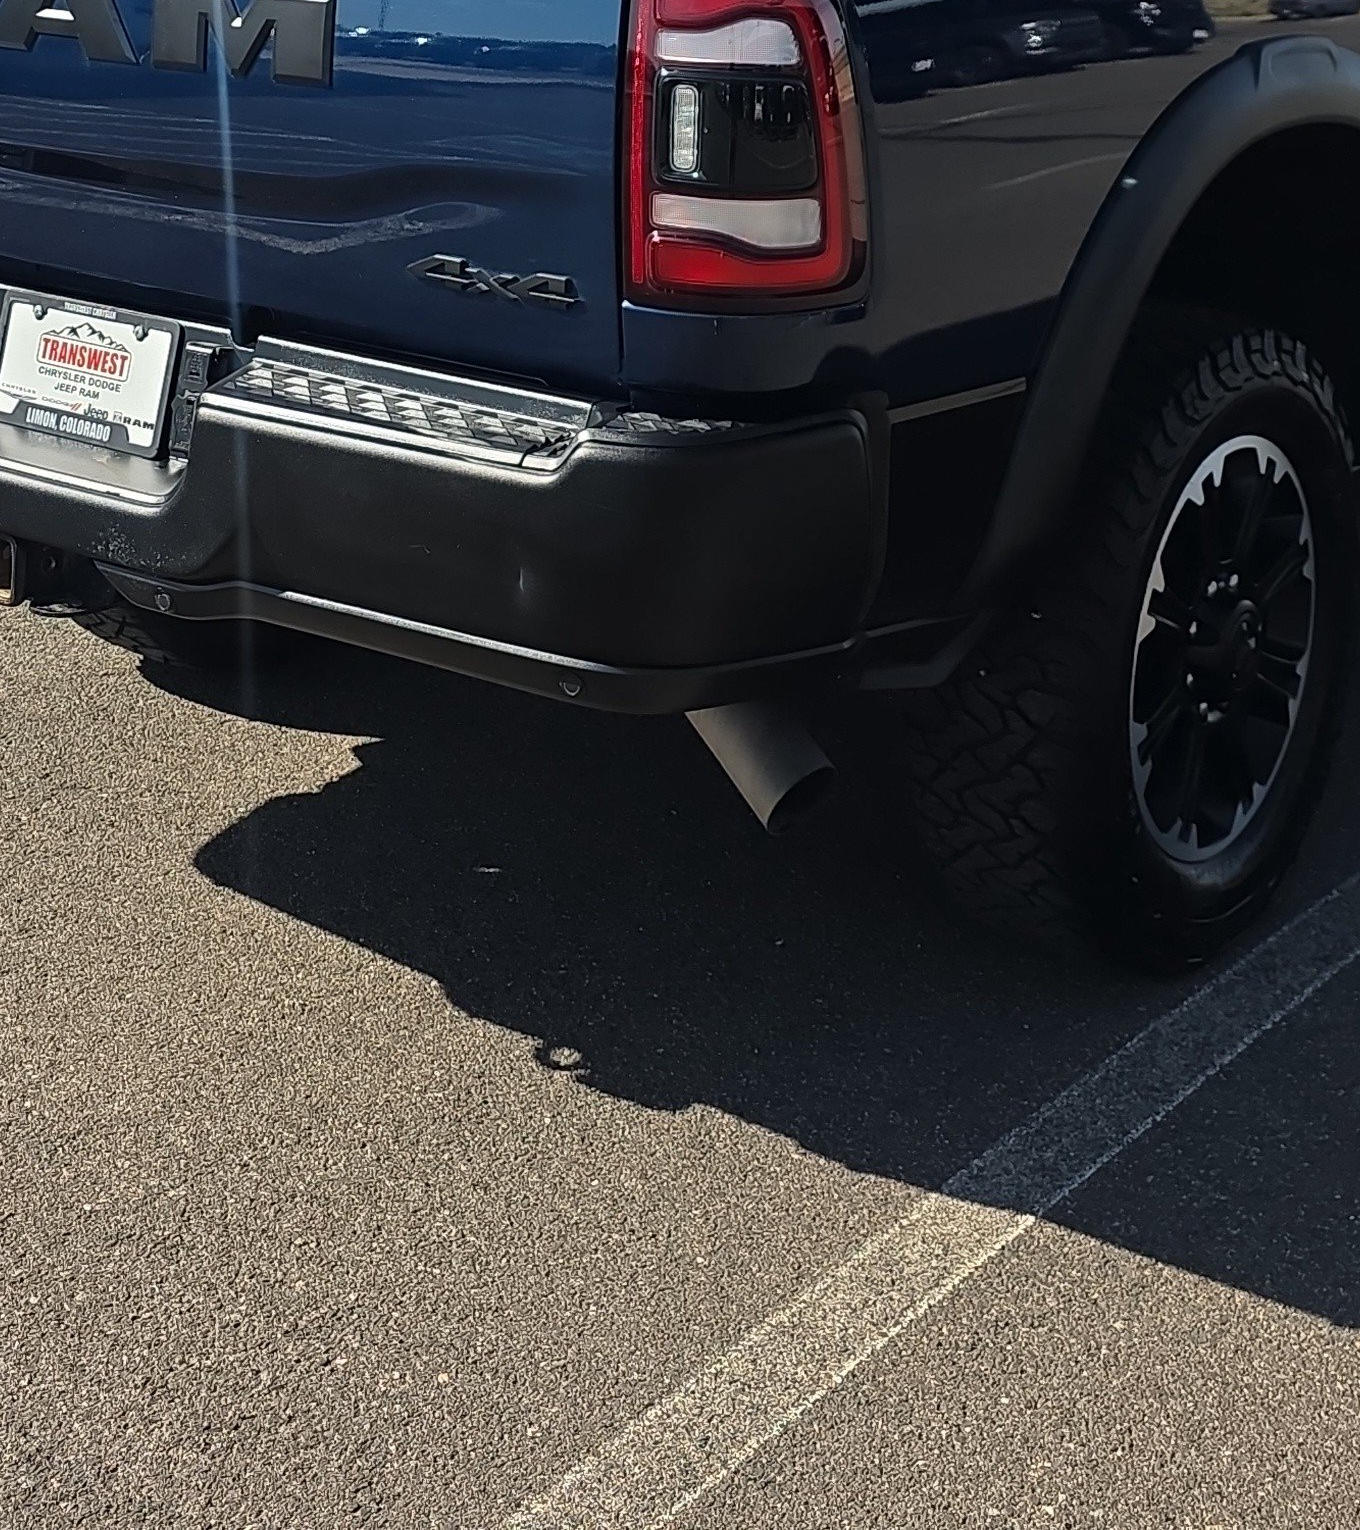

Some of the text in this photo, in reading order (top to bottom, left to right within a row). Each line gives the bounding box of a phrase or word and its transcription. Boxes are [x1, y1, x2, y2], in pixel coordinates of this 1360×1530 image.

[41, 337, 128, 378] TRANSWEST
[38, 365, 121, 393] CHRYSLER DODGE
[54, 382, 100, 399] JEEP RAM
[26, 406, 112, 442] LIMON, COLORADO
[123, 416, 155, 430] RAM
